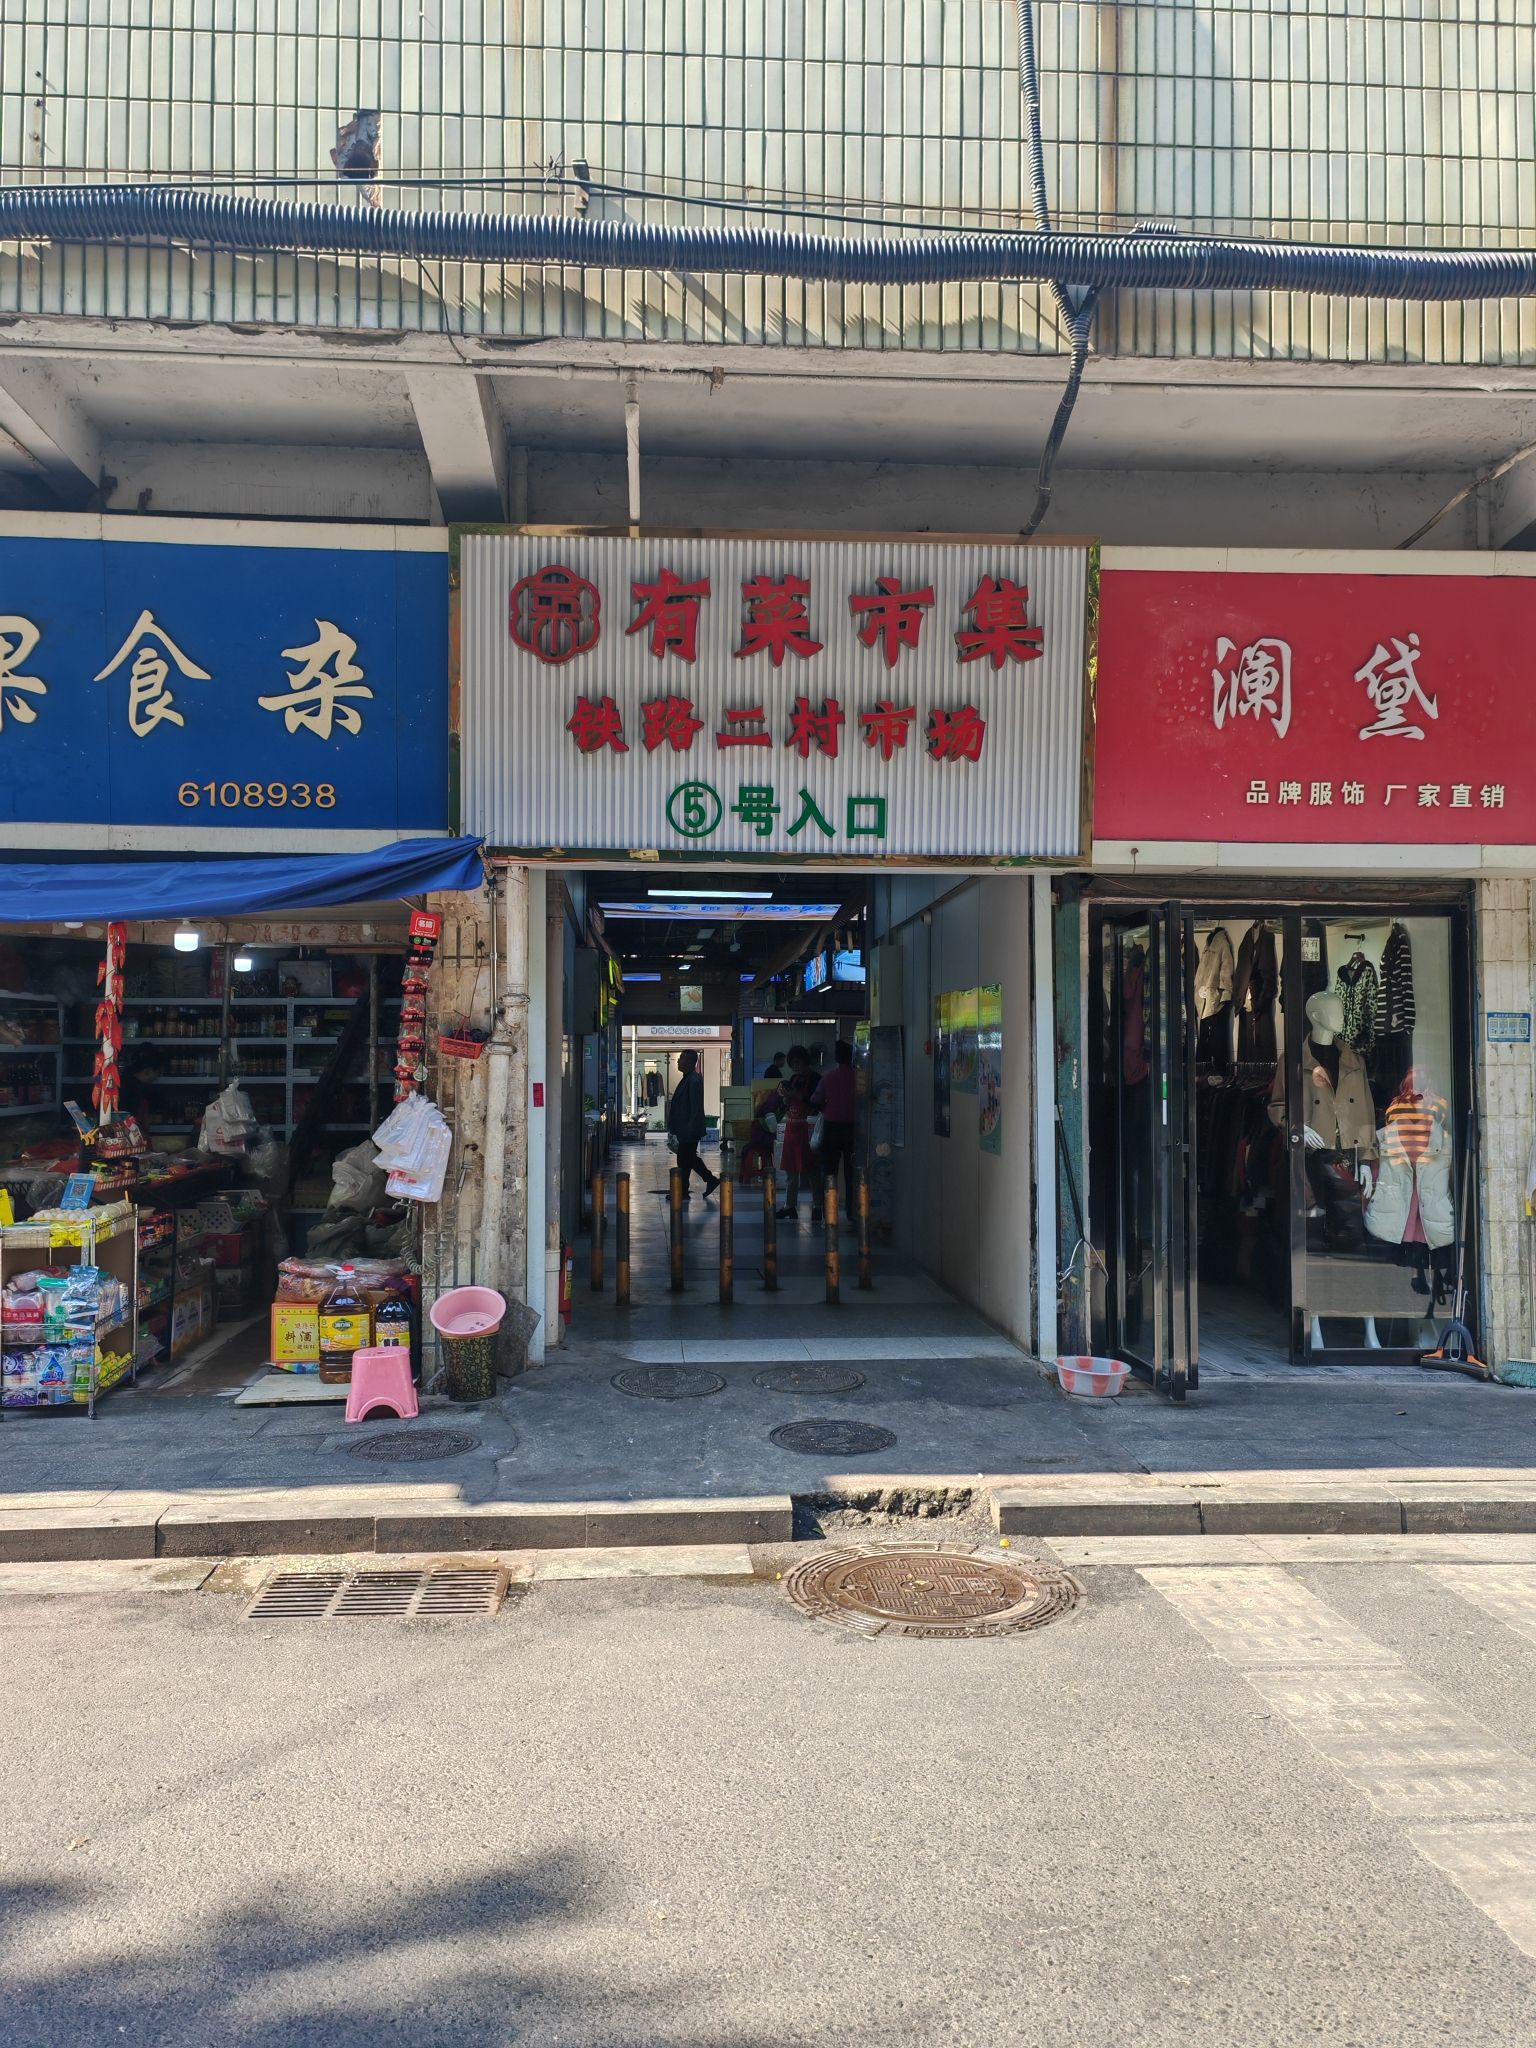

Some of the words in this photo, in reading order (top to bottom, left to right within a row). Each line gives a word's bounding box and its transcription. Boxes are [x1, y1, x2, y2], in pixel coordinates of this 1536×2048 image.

[625, 568, 1044, 671] 有菜市集
[1211, 632, 1439, 741] 澜黛
[566, 695, 986, 763] 铁路二村市场
[177, 781, 337, 809] 6108938
[1245, 780, 1366, 807] 品牌服饰
[1383, 783, 1506, 809] 厂家直销
